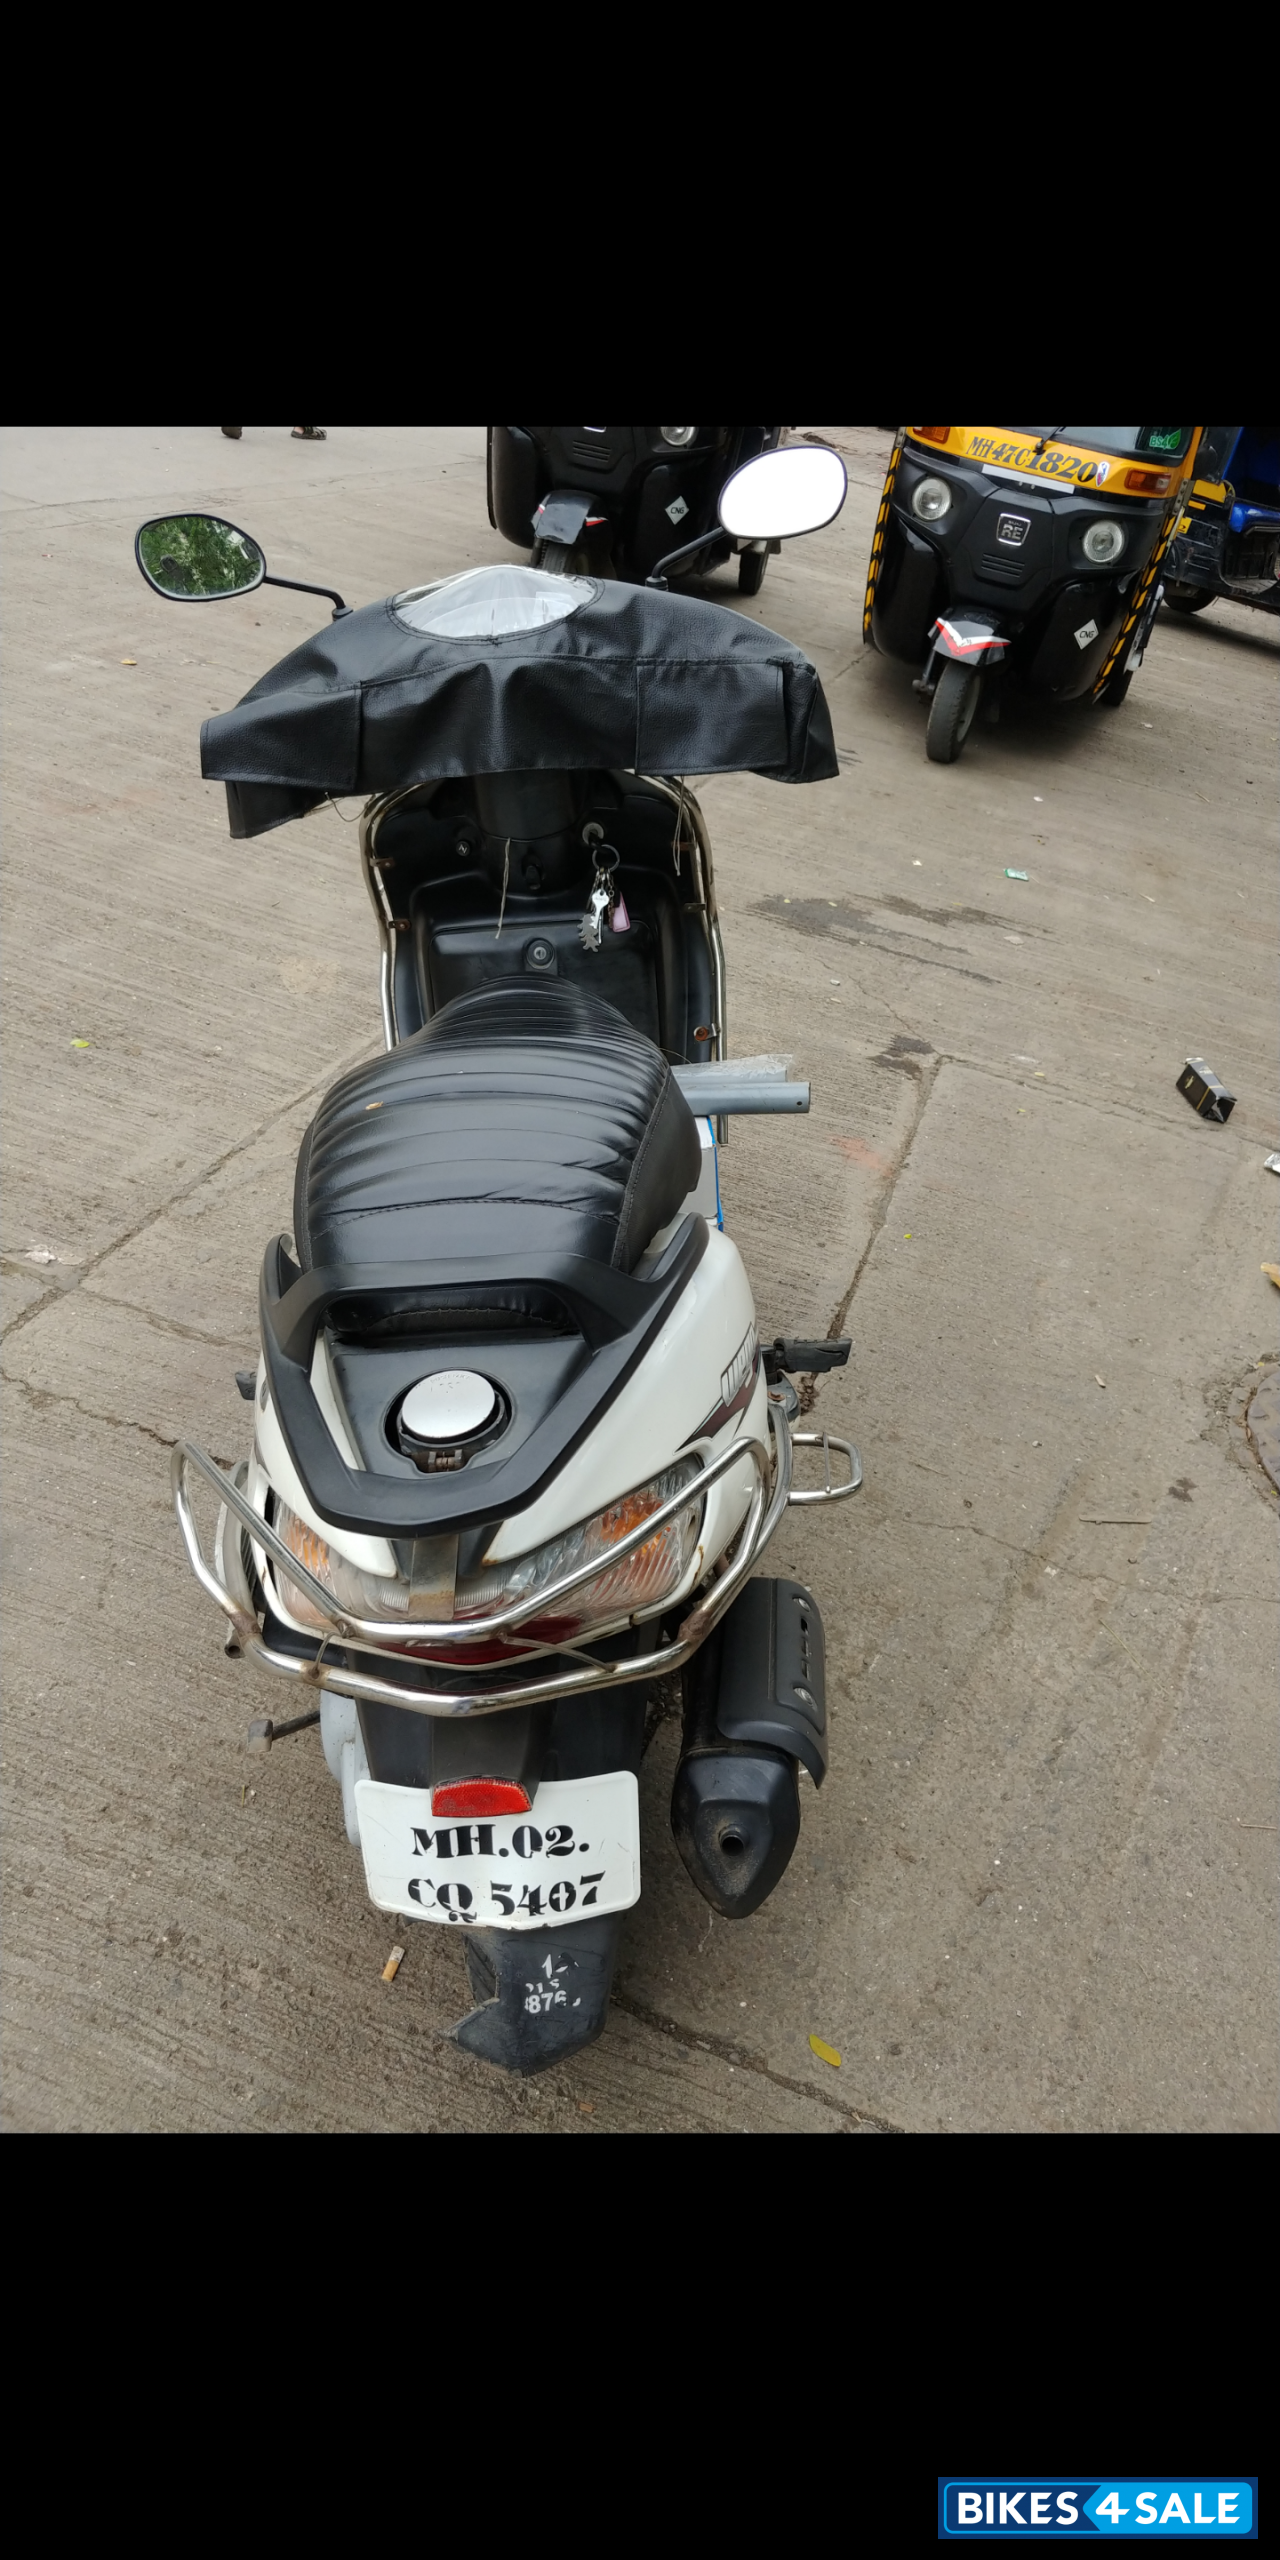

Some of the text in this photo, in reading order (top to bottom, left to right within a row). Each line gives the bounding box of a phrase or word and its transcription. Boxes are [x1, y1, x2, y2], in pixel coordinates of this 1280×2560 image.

[1001, 523, 1023, 540] RE
[407, 1871, 606, 1923] CQ 5407
